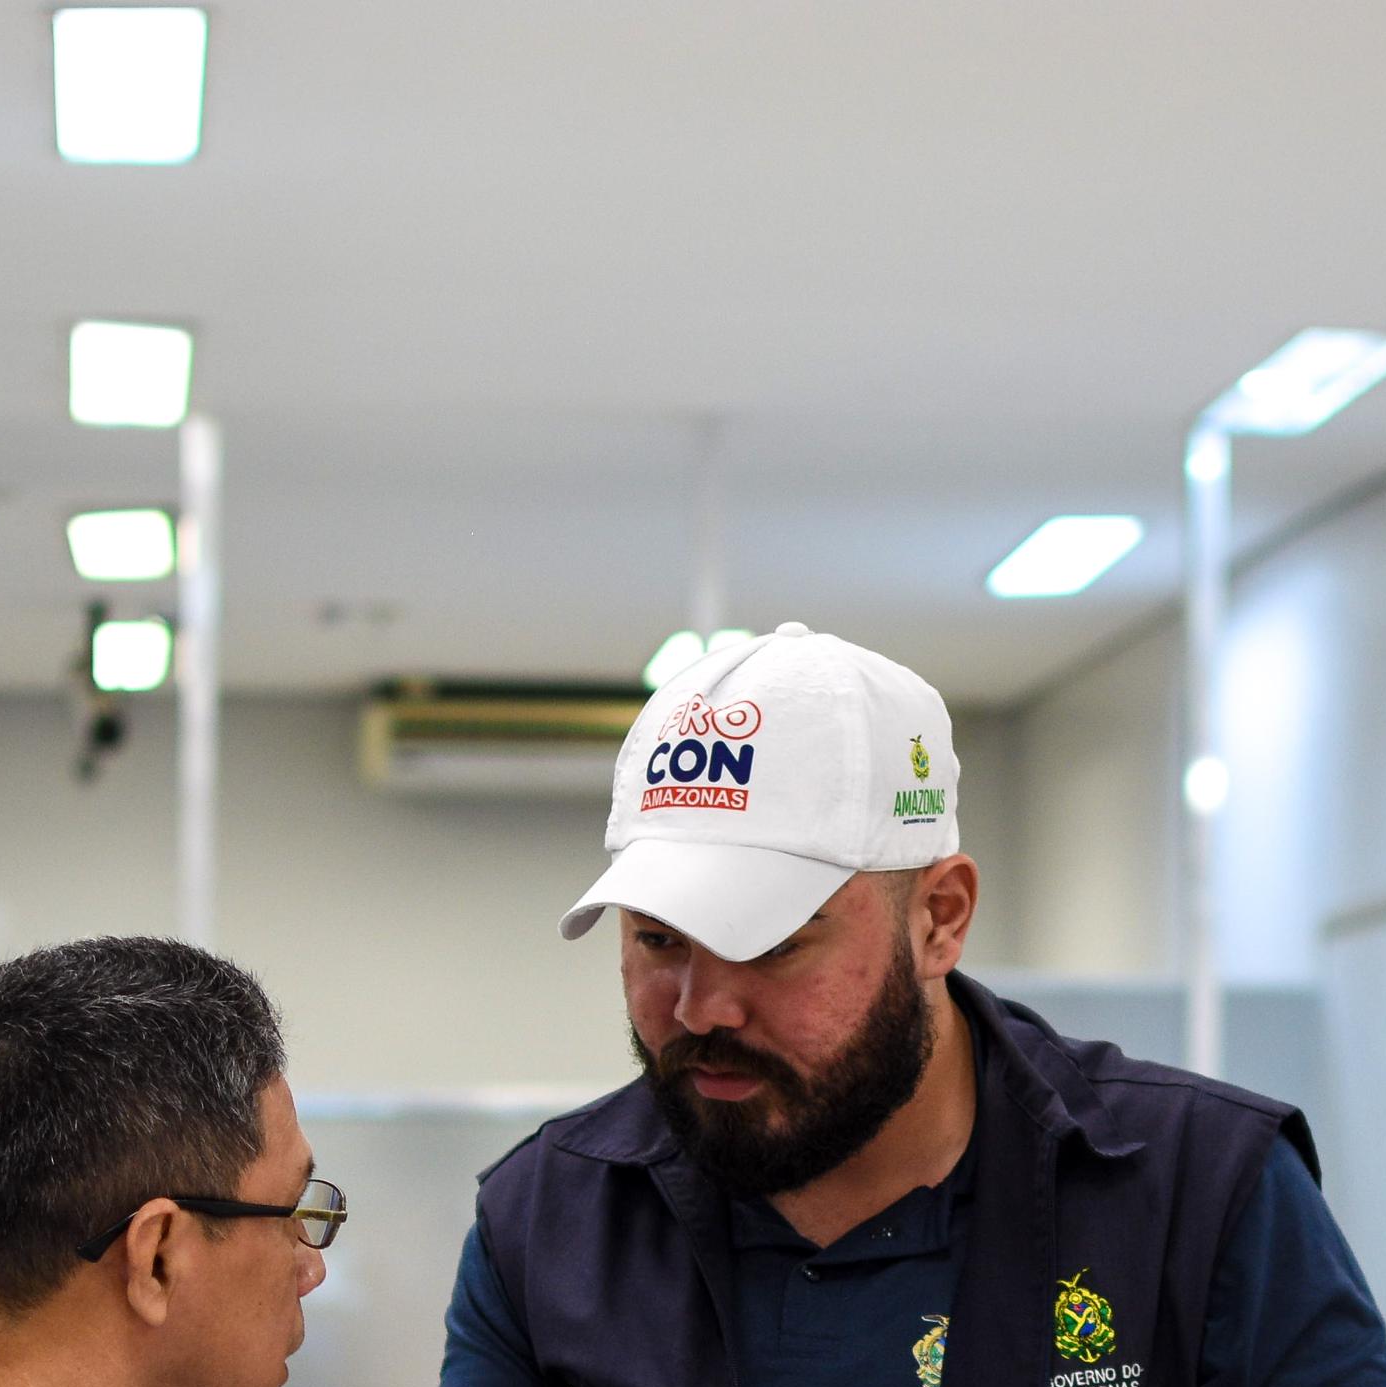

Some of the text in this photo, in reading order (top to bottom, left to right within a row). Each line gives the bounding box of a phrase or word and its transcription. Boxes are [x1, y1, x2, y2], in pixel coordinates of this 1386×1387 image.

[657, 693, 762, 741] PRO
[646, 738, 755, 786] CON
[642, 788, 747, 810] AMAZONAS
[892, 788, 946, 818] AMAZONAS
